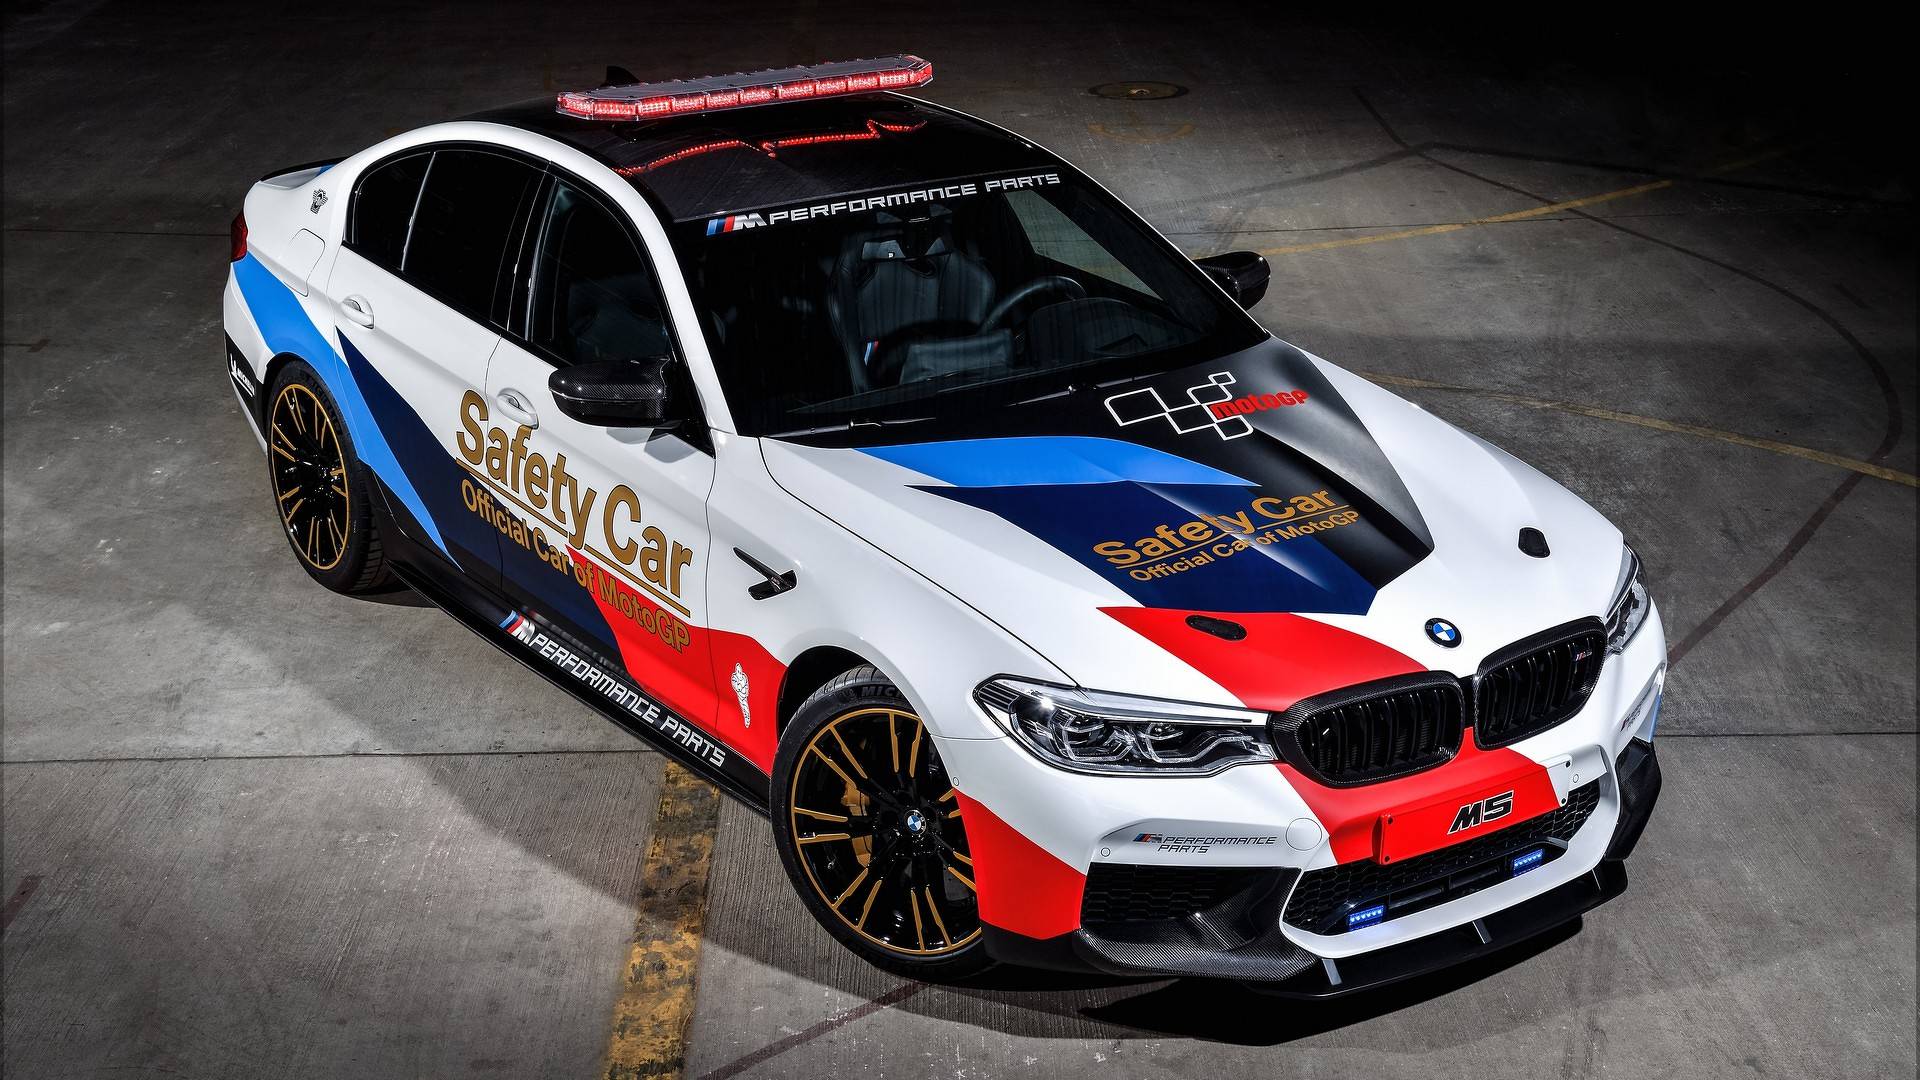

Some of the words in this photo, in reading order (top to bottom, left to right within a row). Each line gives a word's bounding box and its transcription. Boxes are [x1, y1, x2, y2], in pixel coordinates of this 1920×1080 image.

[769, 183, 977, 226] PERFORMANCE
[985, 173, 1060, 192] PARTS
[456, 389, 597, 550] Safety
[603, 484, 693, 598] Car
[1093, 510, 1256, 565] Safety
[1251, 488, 1338, 520] Car
[461, 479, 531, 550] Official
[532, 527, 570, 575] Car
[573, 562, 594, 593] of
[597, 569, 691, 654] MotoGP
[1129, 551, 1215, 582] Official
[1212, 537, 1251, 558] Car
[1255, 532, 1277, 546] of
[1276, 510, 1360, 541] MotoGP
[528, 633, 661, 724] PERFORMANCE
[659, 715, 726, 767] PARTS
[1162, 836, 1278, 845] PERFORMANCE
[1447, 790, 1514, 835] M5
[1157, 844, 1211, 854] PARTS
